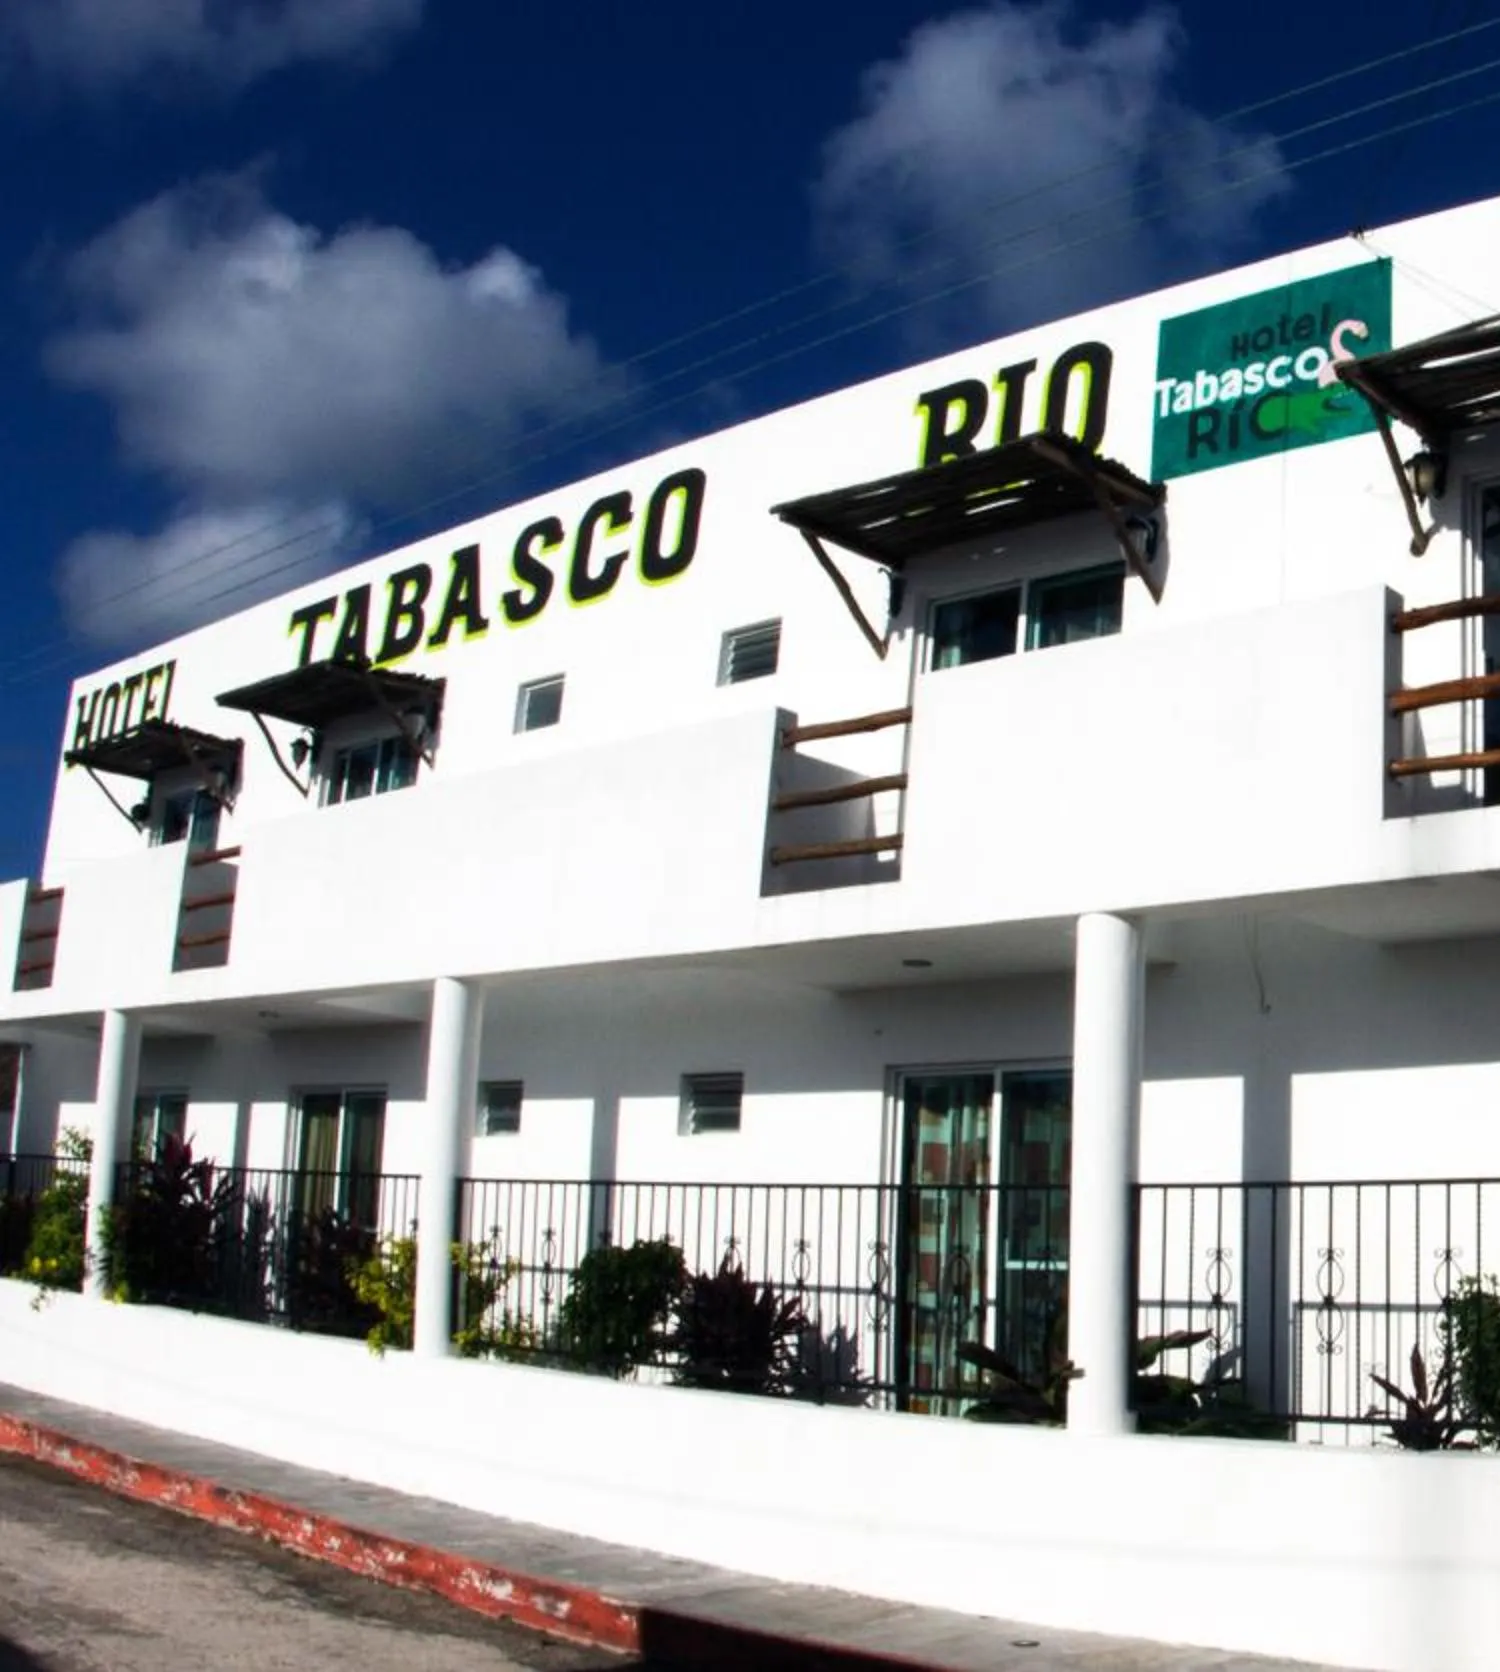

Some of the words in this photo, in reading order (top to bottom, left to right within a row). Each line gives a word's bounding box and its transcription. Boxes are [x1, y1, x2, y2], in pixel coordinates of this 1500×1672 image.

[1154, 346, 1329, 418] Tabasco
[287, 467, 707, 671] TABASCO
[914, 341, 1113, 469] RIO
